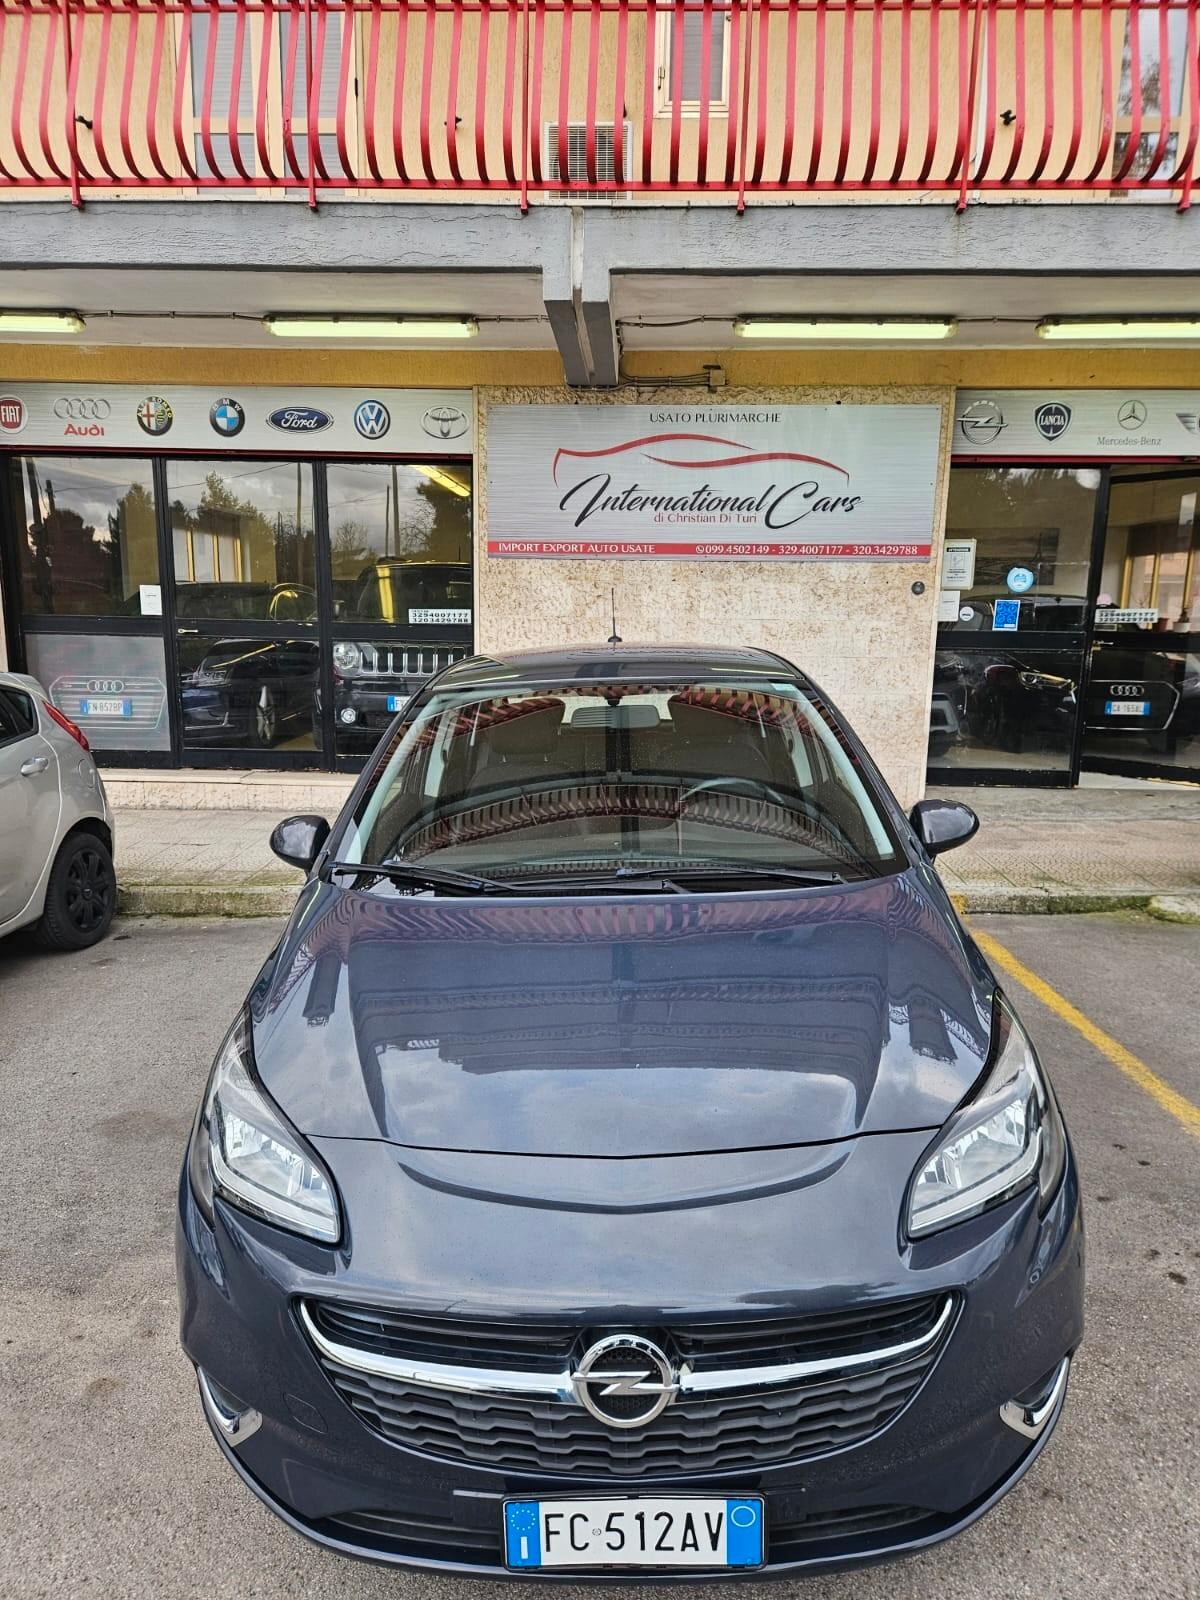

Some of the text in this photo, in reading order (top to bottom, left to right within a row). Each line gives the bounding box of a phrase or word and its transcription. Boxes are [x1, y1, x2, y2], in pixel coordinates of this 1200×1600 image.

[0, 405, 20, 423] FIAT
[281, 410, 318, 428] Ford
[649, 412, 782, 423] USATO PLURIMARCHE
[1040, 415, 1065, 426] LANCIA
[64, 423, 105, 436] Audi
[1096, 436, 1162, 447] Mercedes-Benz
[559, 473, 864, 529] International Cars
[653, 512, 758, 524] di Christian Di Turi
[498, 543, 656, 554] IMPORT EXPORT AUTO USATE
[704, 545, 770, 555] 099.4502149
[778, 545, 843, 555] 329.4007177
[852, 545, 918, 556] 320.3429788
